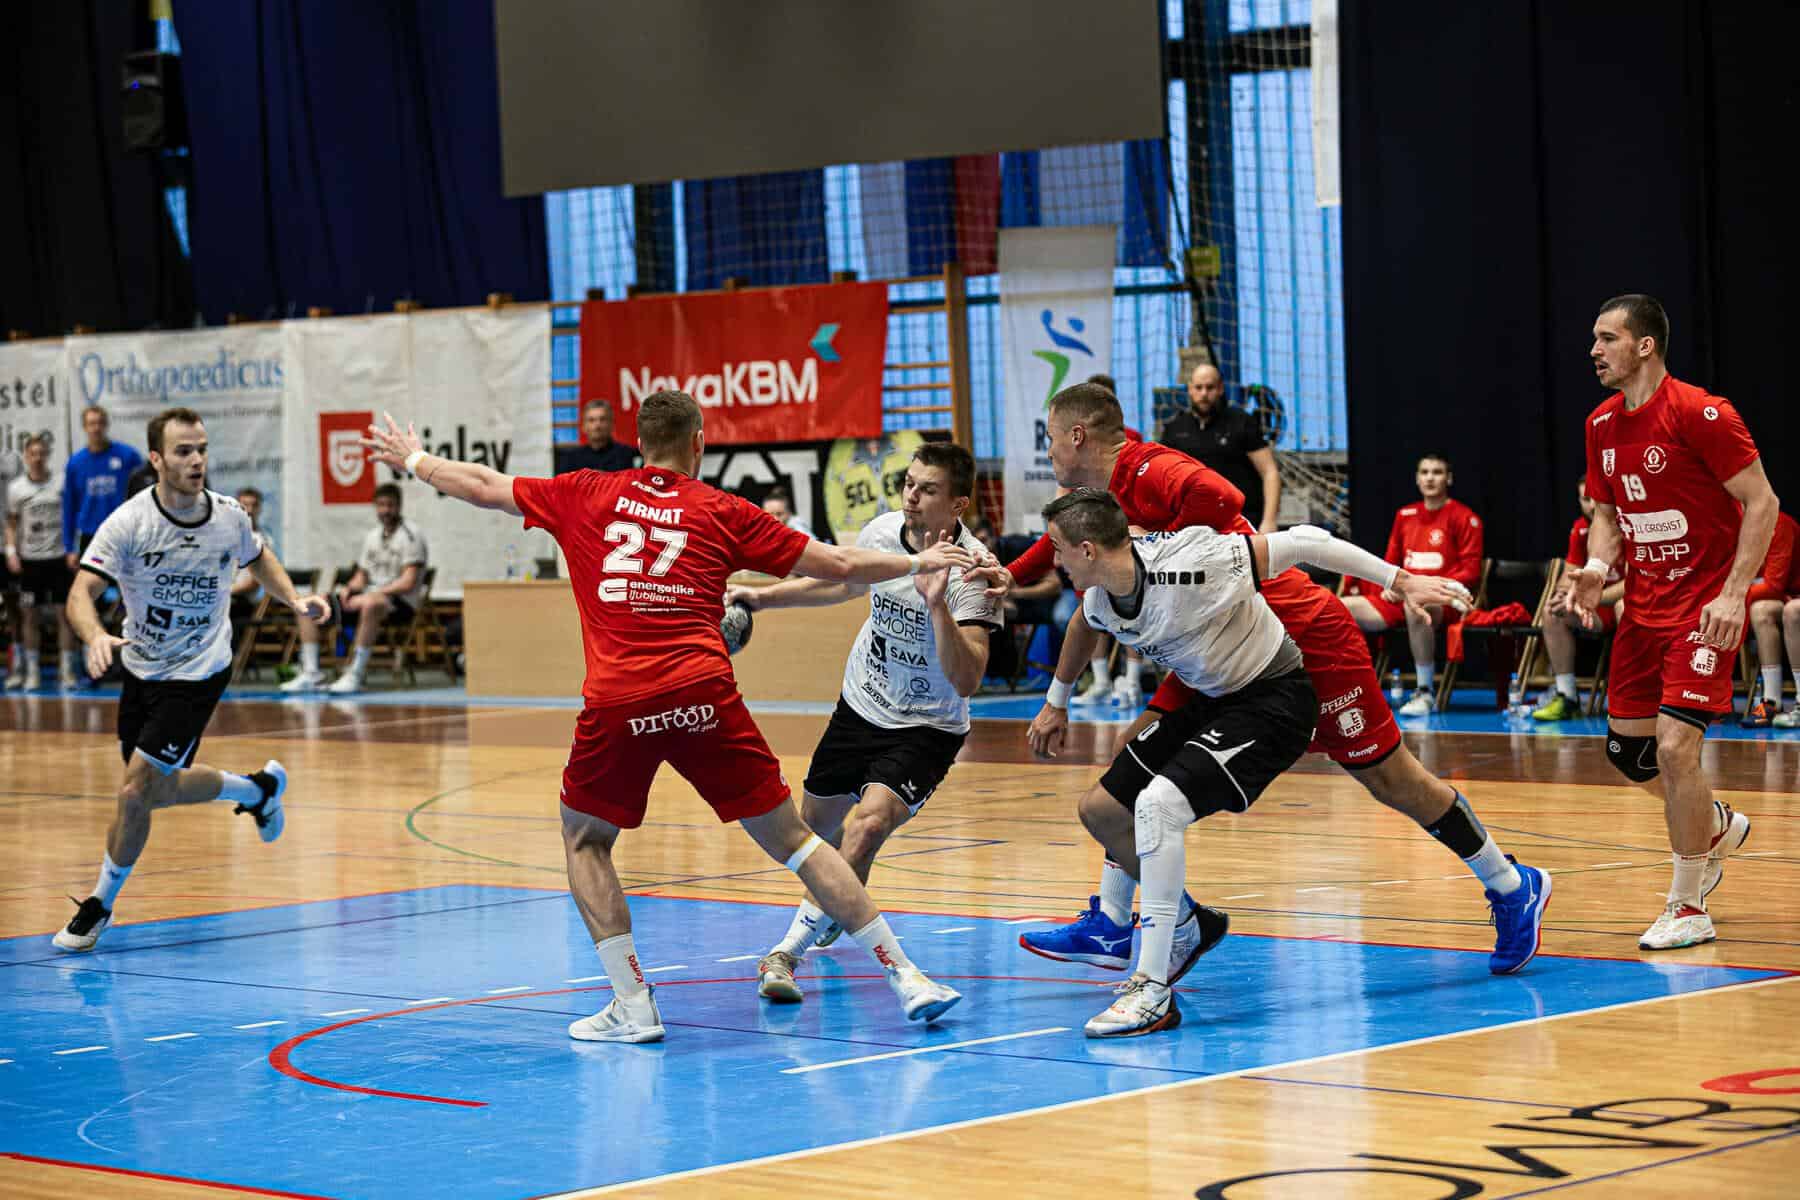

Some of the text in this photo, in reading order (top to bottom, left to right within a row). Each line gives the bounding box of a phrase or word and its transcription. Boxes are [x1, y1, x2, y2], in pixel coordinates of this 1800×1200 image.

[80, 349, 285, 404] Orthopaedicus
[1621, 474, 1648, 502] 19
[614, 496, 684, 524] PIRNAT
[143, 552, 165, 568] 17
[602, 520, 688, 577] 27
[1647, 543, 1690, 562] LPP
[155, 574, 218, 589] OFFICE
[629, 581, 695, 596] energetika
[873, 593, 926, 625] OFFICE
[890, 646, 929, 666] SAVA
